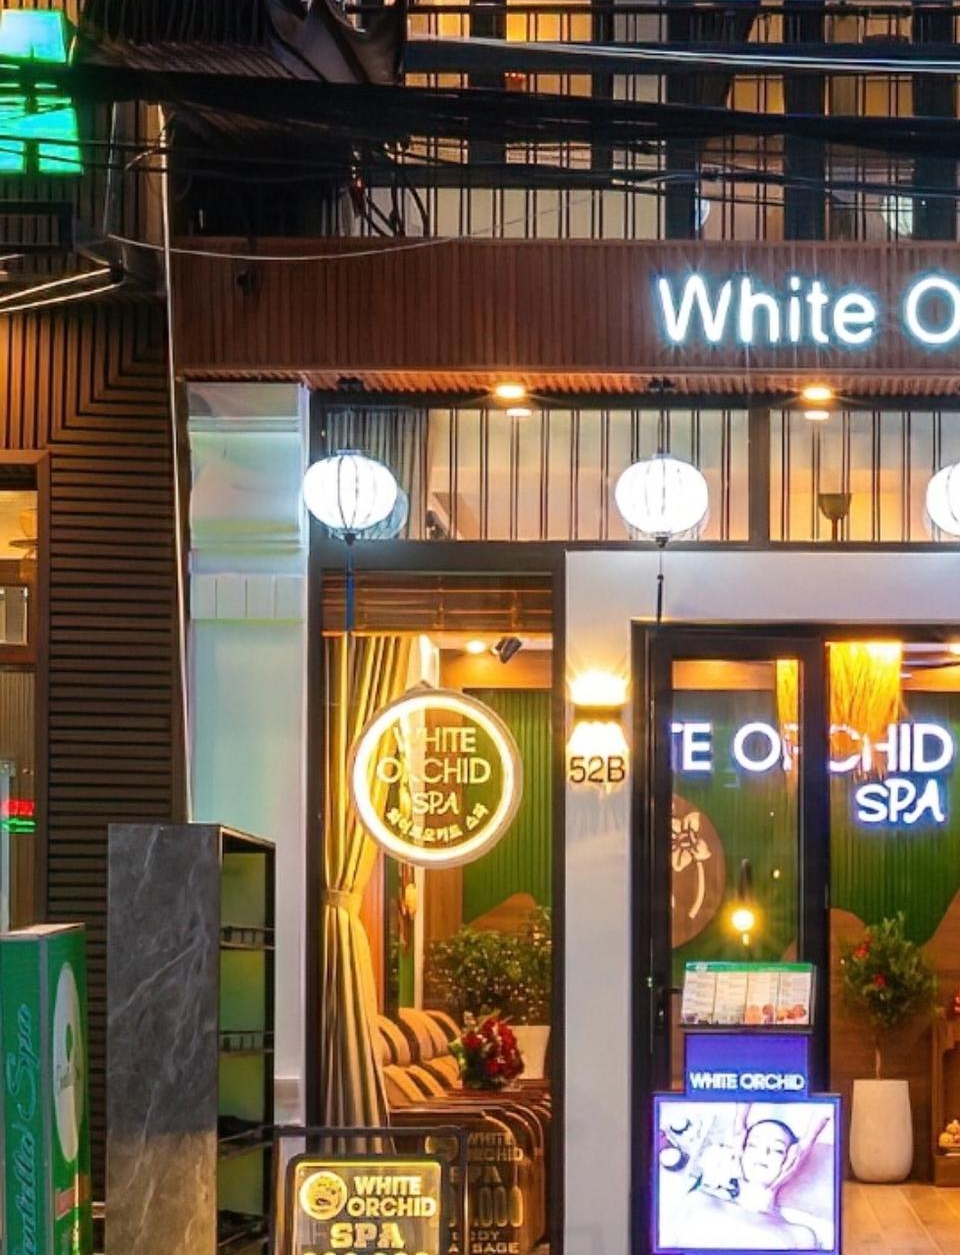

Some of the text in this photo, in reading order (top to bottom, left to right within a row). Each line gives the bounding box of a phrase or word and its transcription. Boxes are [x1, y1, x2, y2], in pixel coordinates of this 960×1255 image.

[657, 274, 877, 344] White
[569, 755, 626, 783] 52B
[412, 790, 460, 816] SPA
[856, 778, 945, 824] SPA
[6, 1003, 40, 1121] Spa
[690, 1072, 806, 1092] WHITE ORCHID
[354, 1176, 421, 1195] WHITE
[346, 1196, 437, 1217] ORCHID
[330, 1222, 405, 1249] SPA
